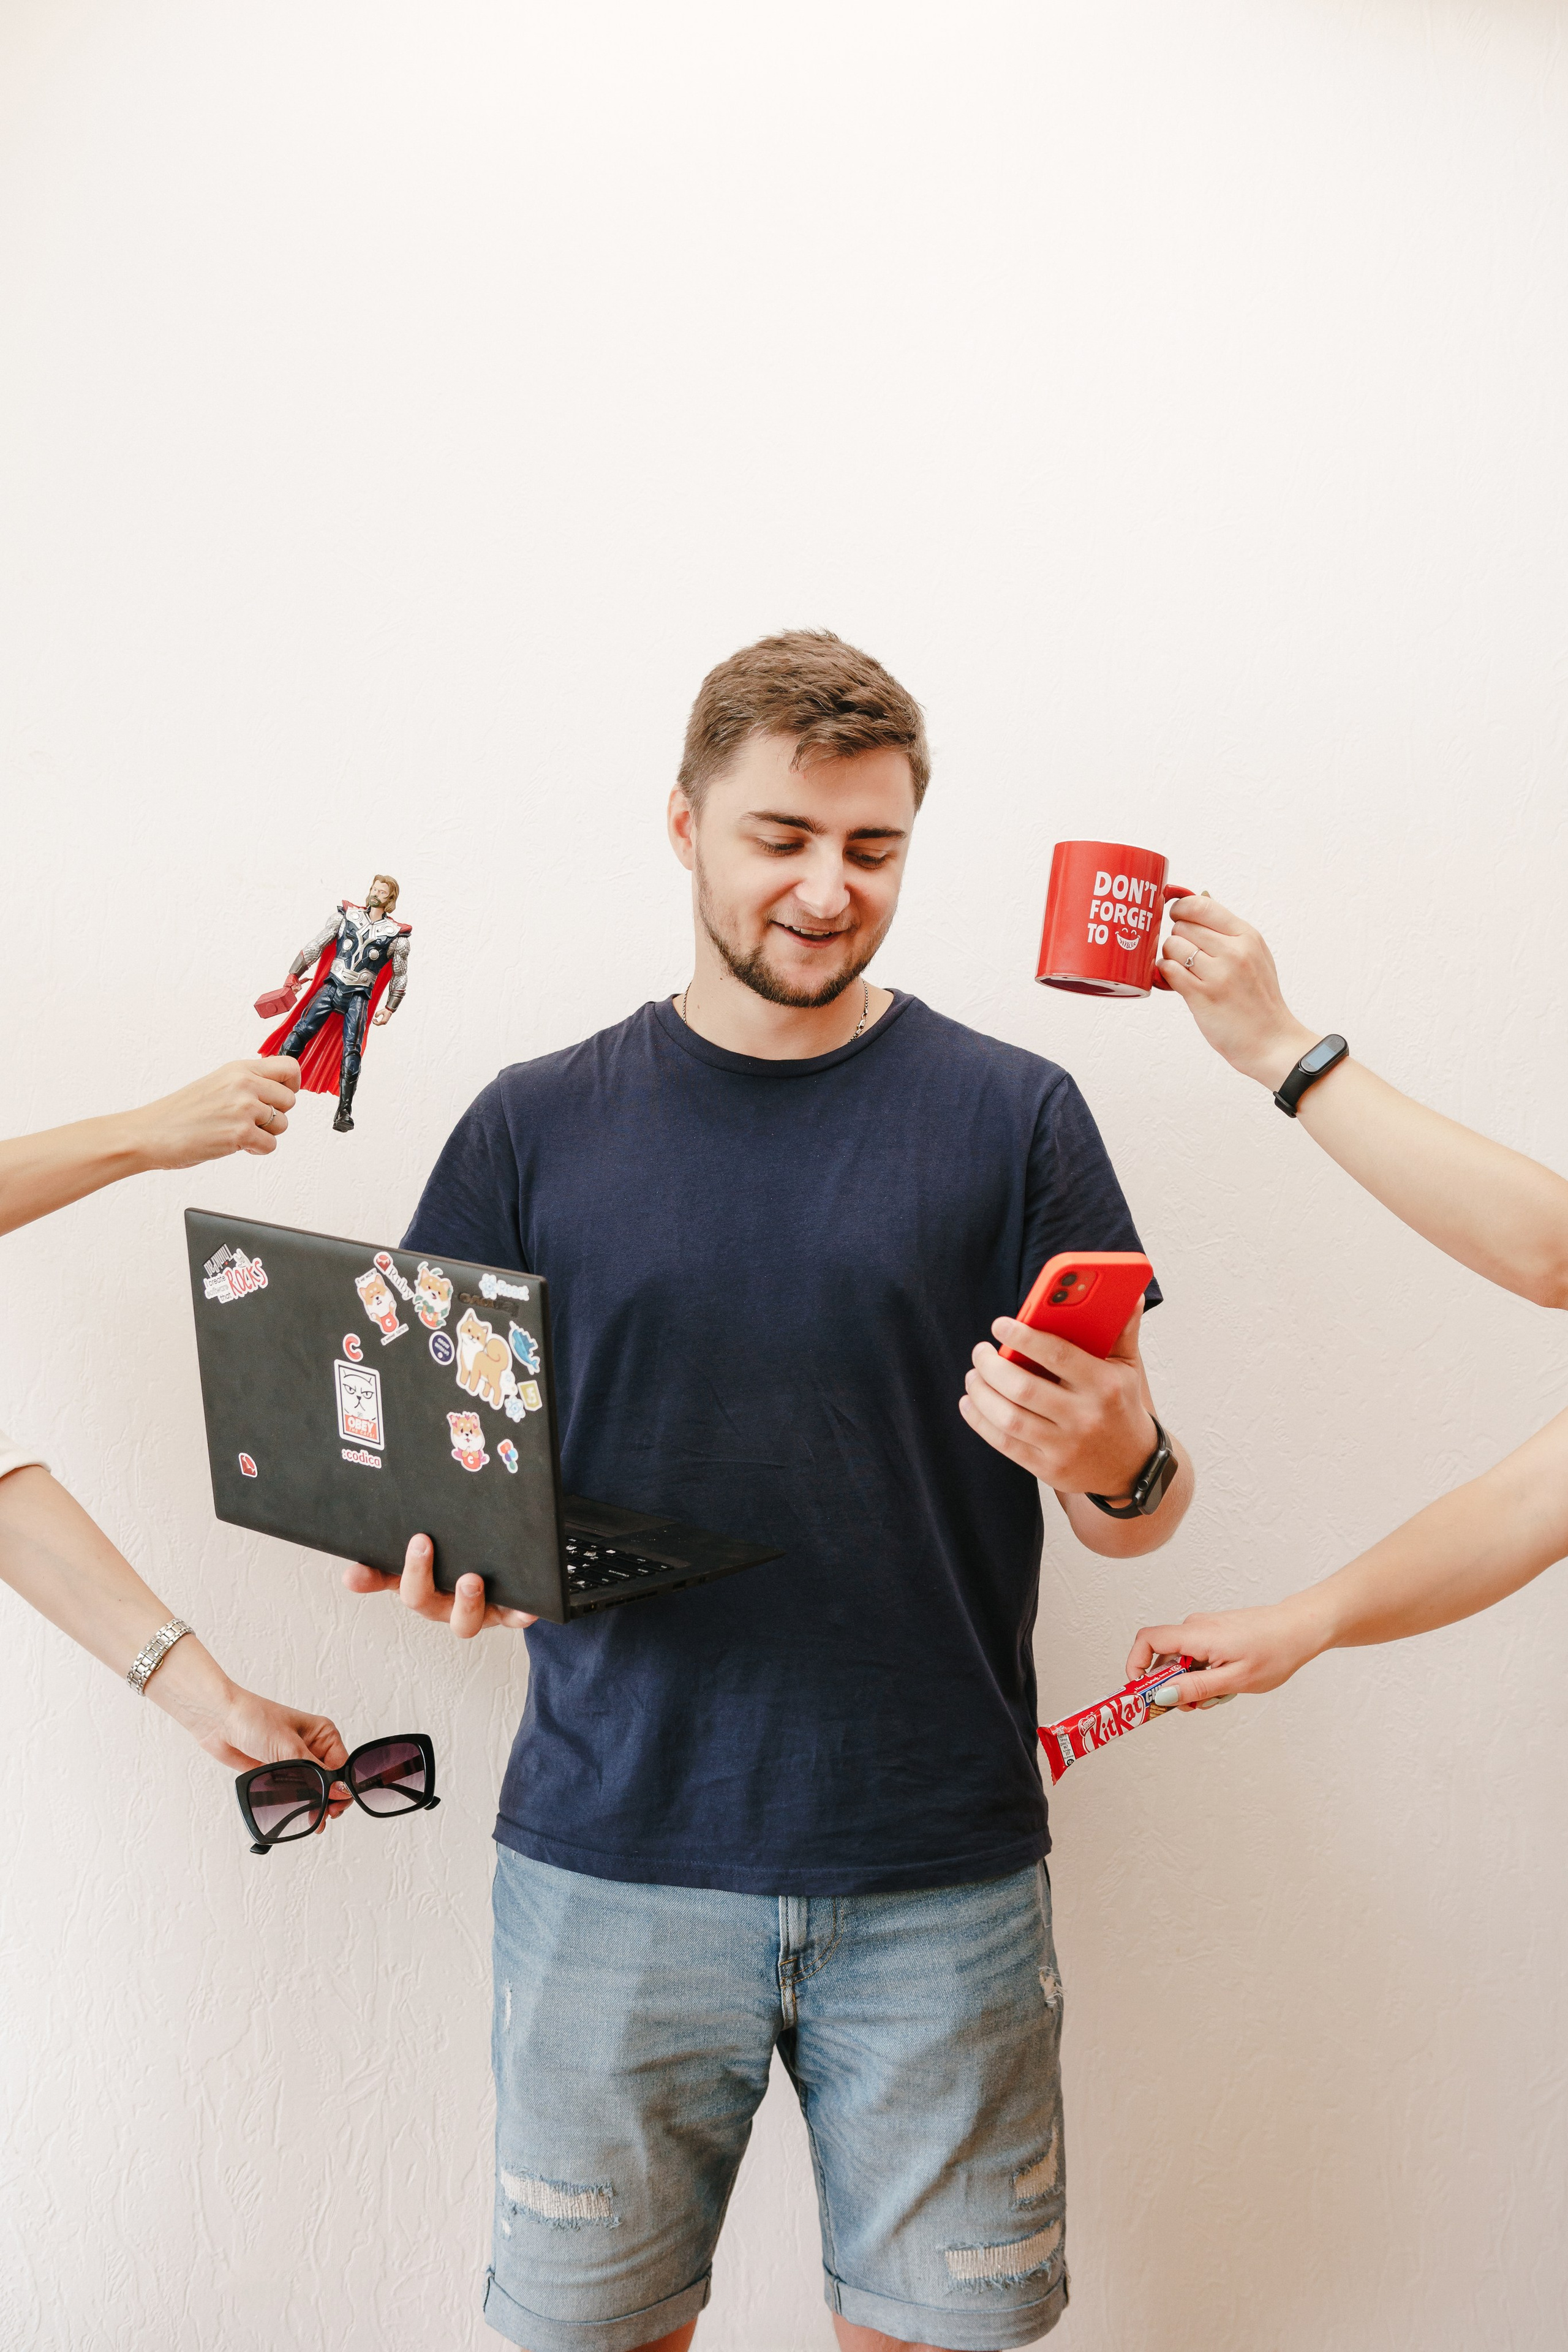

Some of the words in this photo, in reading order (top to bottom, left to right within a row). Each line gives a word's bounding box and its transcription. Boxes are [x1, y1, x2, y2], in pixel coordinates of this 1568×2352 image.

[1093, 871, 1158, 908] DON'T
[1090, 899, 1153, 932] FORGET
[1087, 922, 1109, 945] TO
[203, 1243, 233, 1278] ThinkPad
[209, 1275, 226, 1286] create
[225, 1261, 266, 1296] ROCKS
[388, 1268, 413, 1299] Ruby
[220, 1292, 232, 1301] that
[347, 1417, 374, 1433] OBEY
[1090, 1695, 1142, 1750] KitKat
